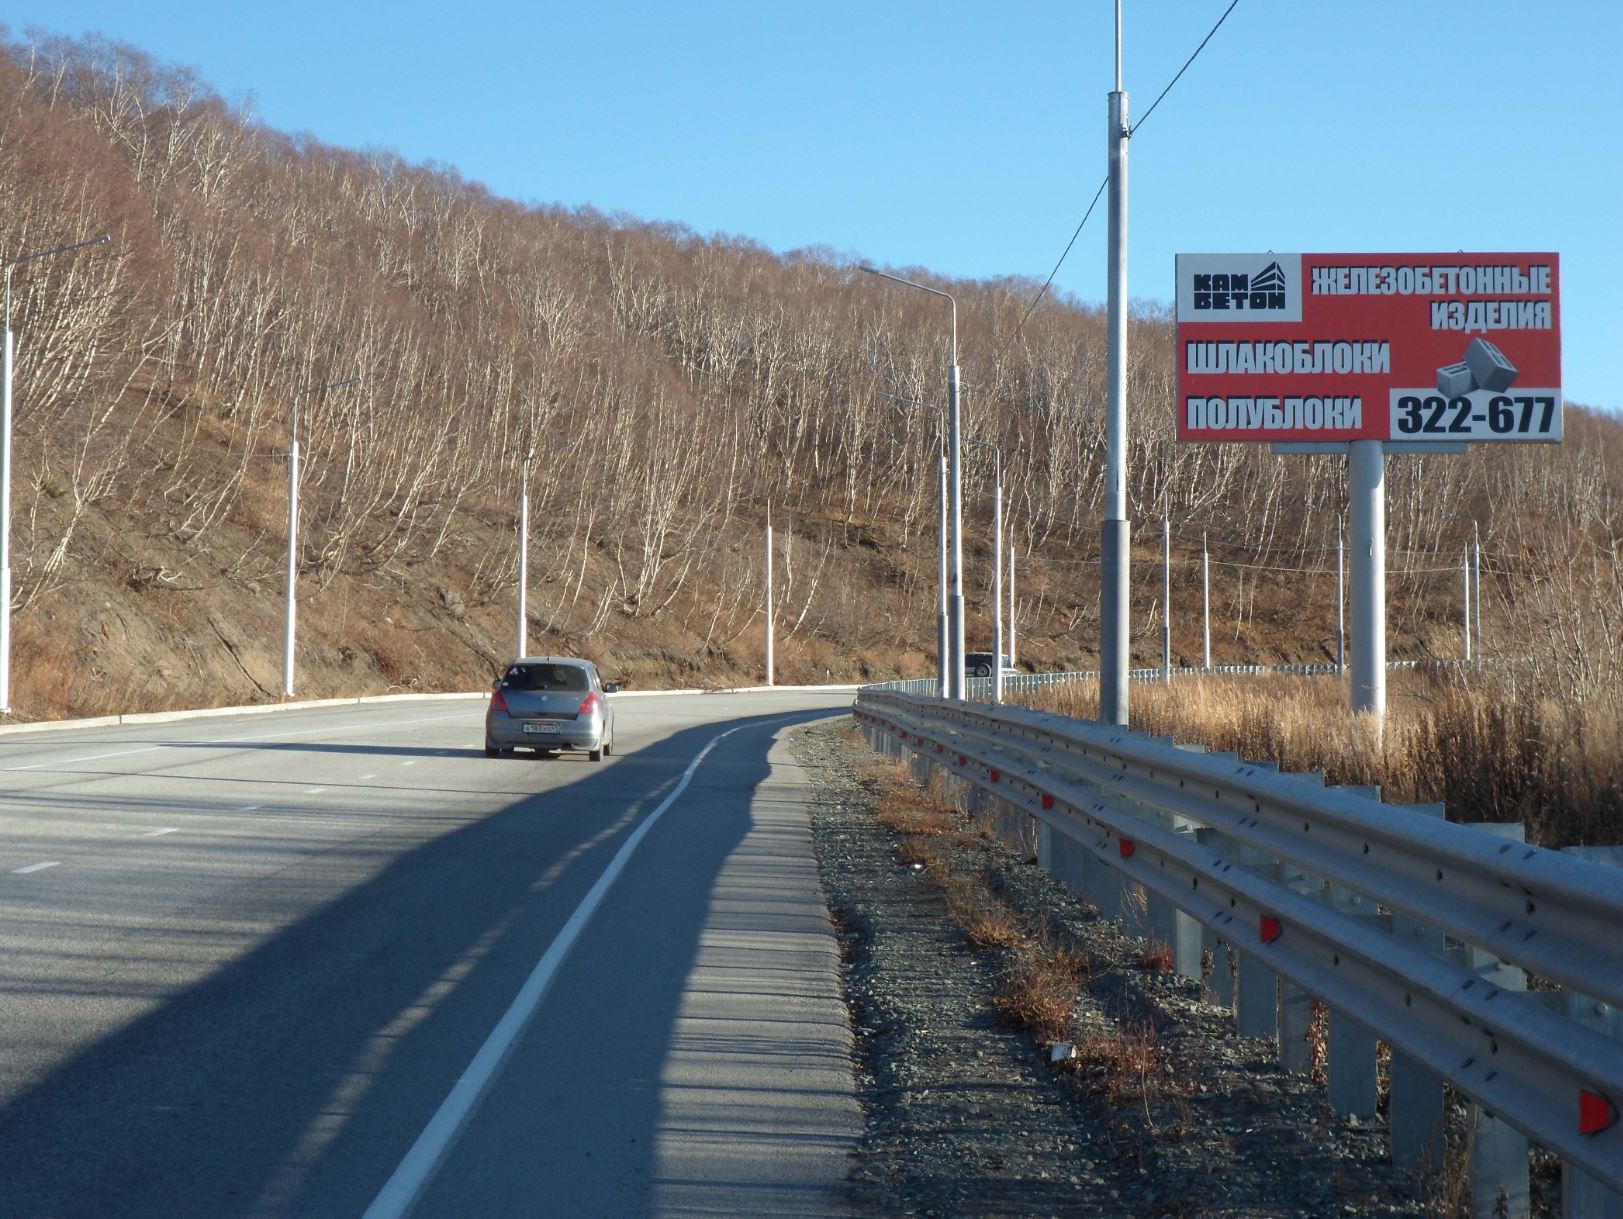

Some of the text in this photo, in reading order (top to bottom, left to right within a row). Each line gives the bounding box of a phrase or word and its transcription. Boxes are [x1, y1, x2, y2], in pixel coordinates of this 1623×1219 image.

[1194, 274, 1249, 292] КАМ
[1312, 266, 1551, 295] ЖЕЛЕЗОБЕТОННЫЕ
[1194, 293, 1286, 310] БЕТОН
[1431, 301, 1551, 333] ИЗДЕЛИЯ
[1186, 340, 1390, 374] ШЛАКОБЛОКИ
[1186, 396, 1361, 430] ПОЛУБЛОКИ
[1397, 396, 1555, 434] 322-677
